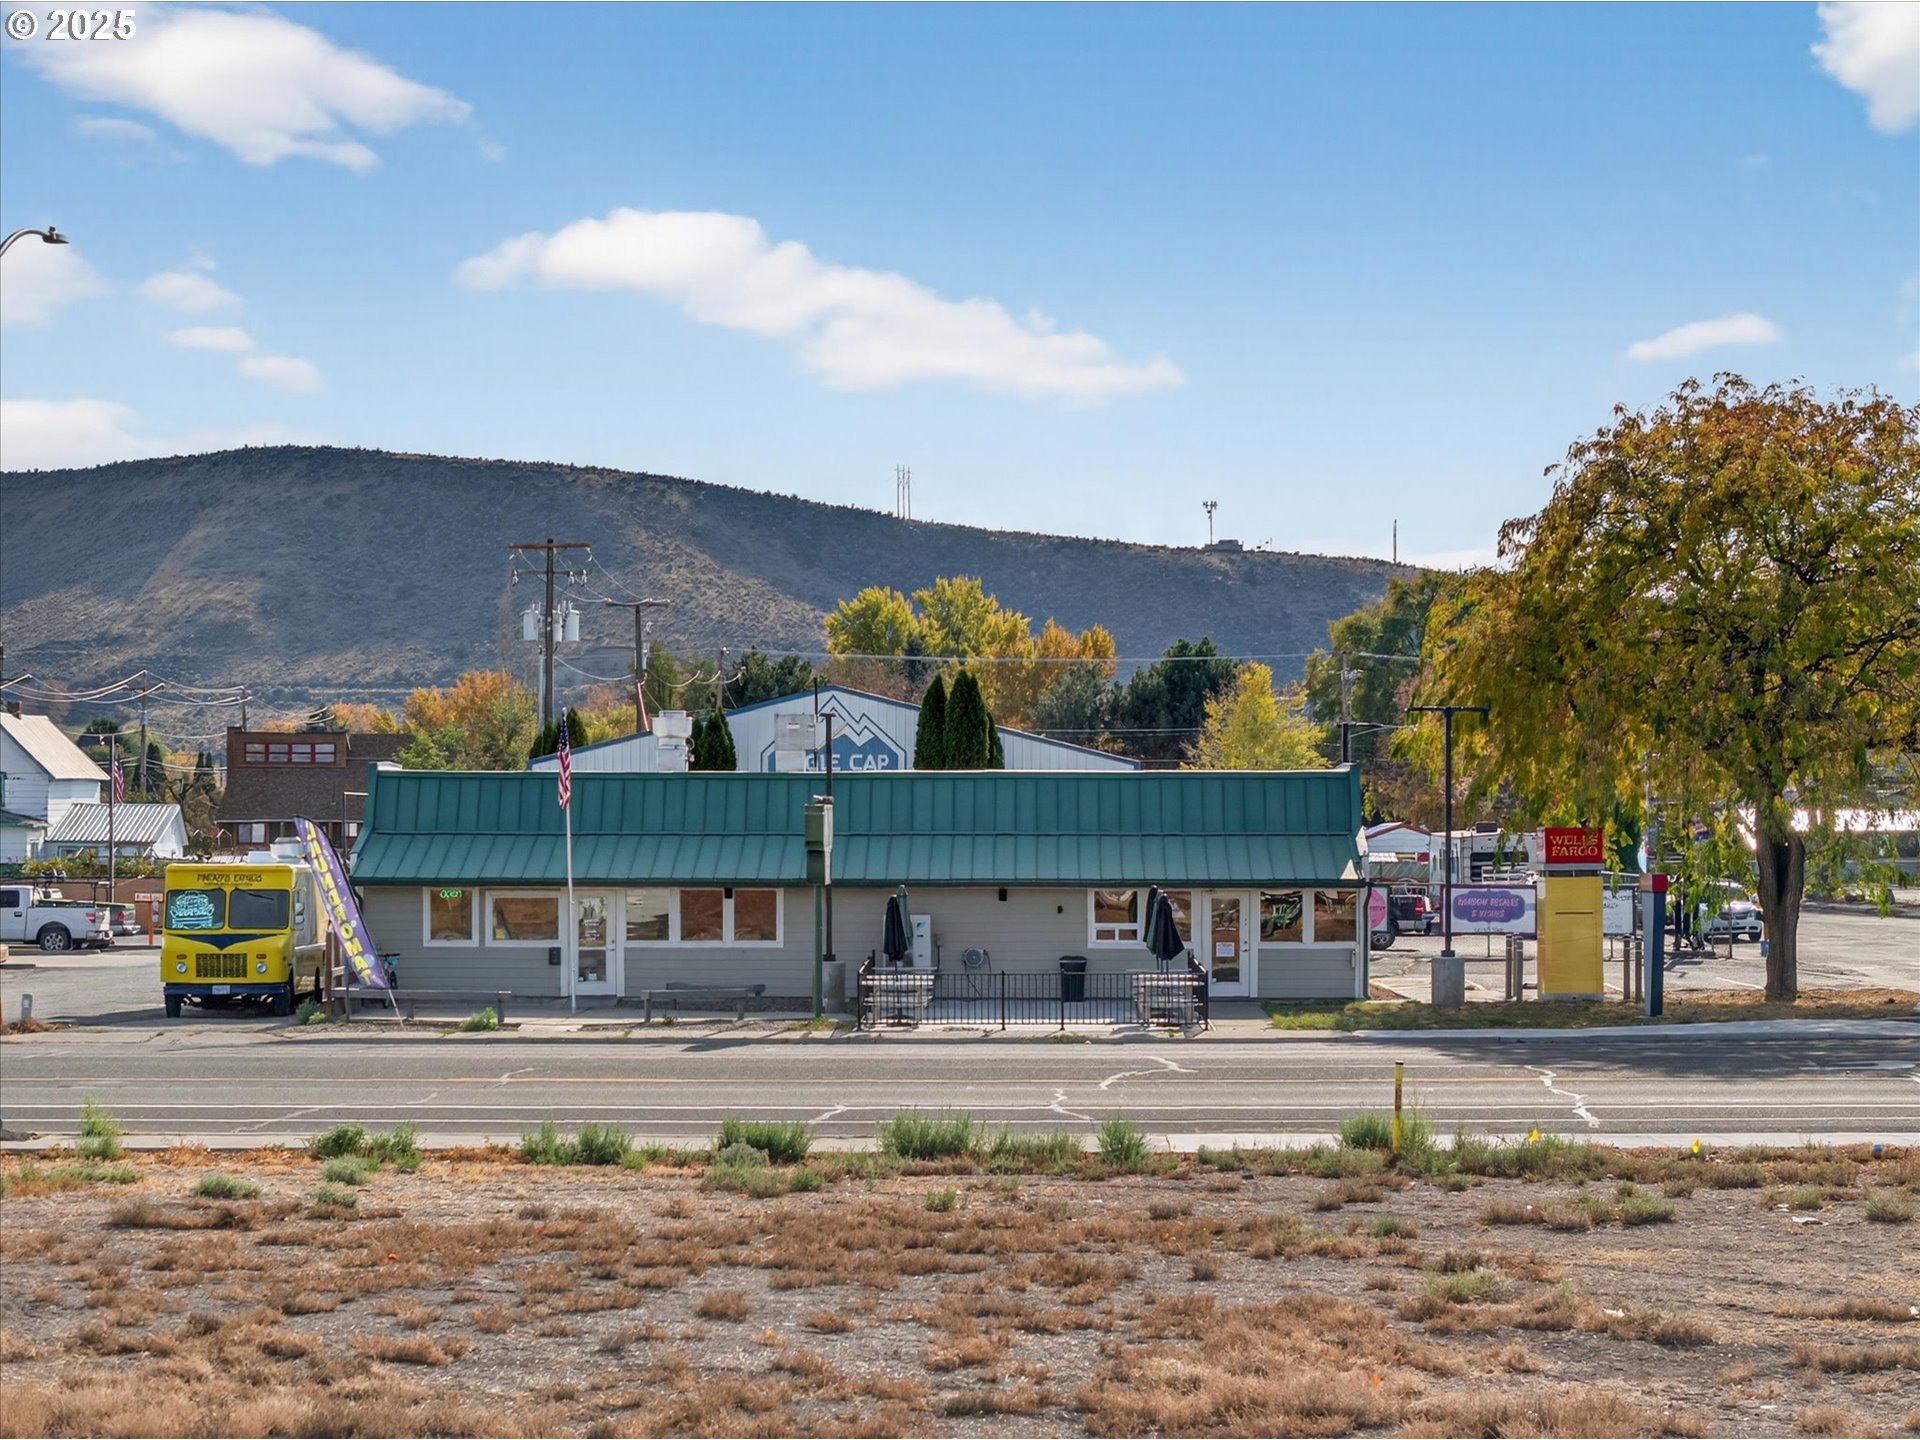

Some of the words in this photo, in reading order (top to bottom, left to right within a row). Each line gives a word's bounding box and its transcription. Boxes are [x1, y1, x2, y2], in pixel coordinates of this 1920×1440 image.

[849, 753, 889, 771] CAP
[1550, 835, 1598, 846] WELLS
[1551, 846, 1598, 857] FARGO
